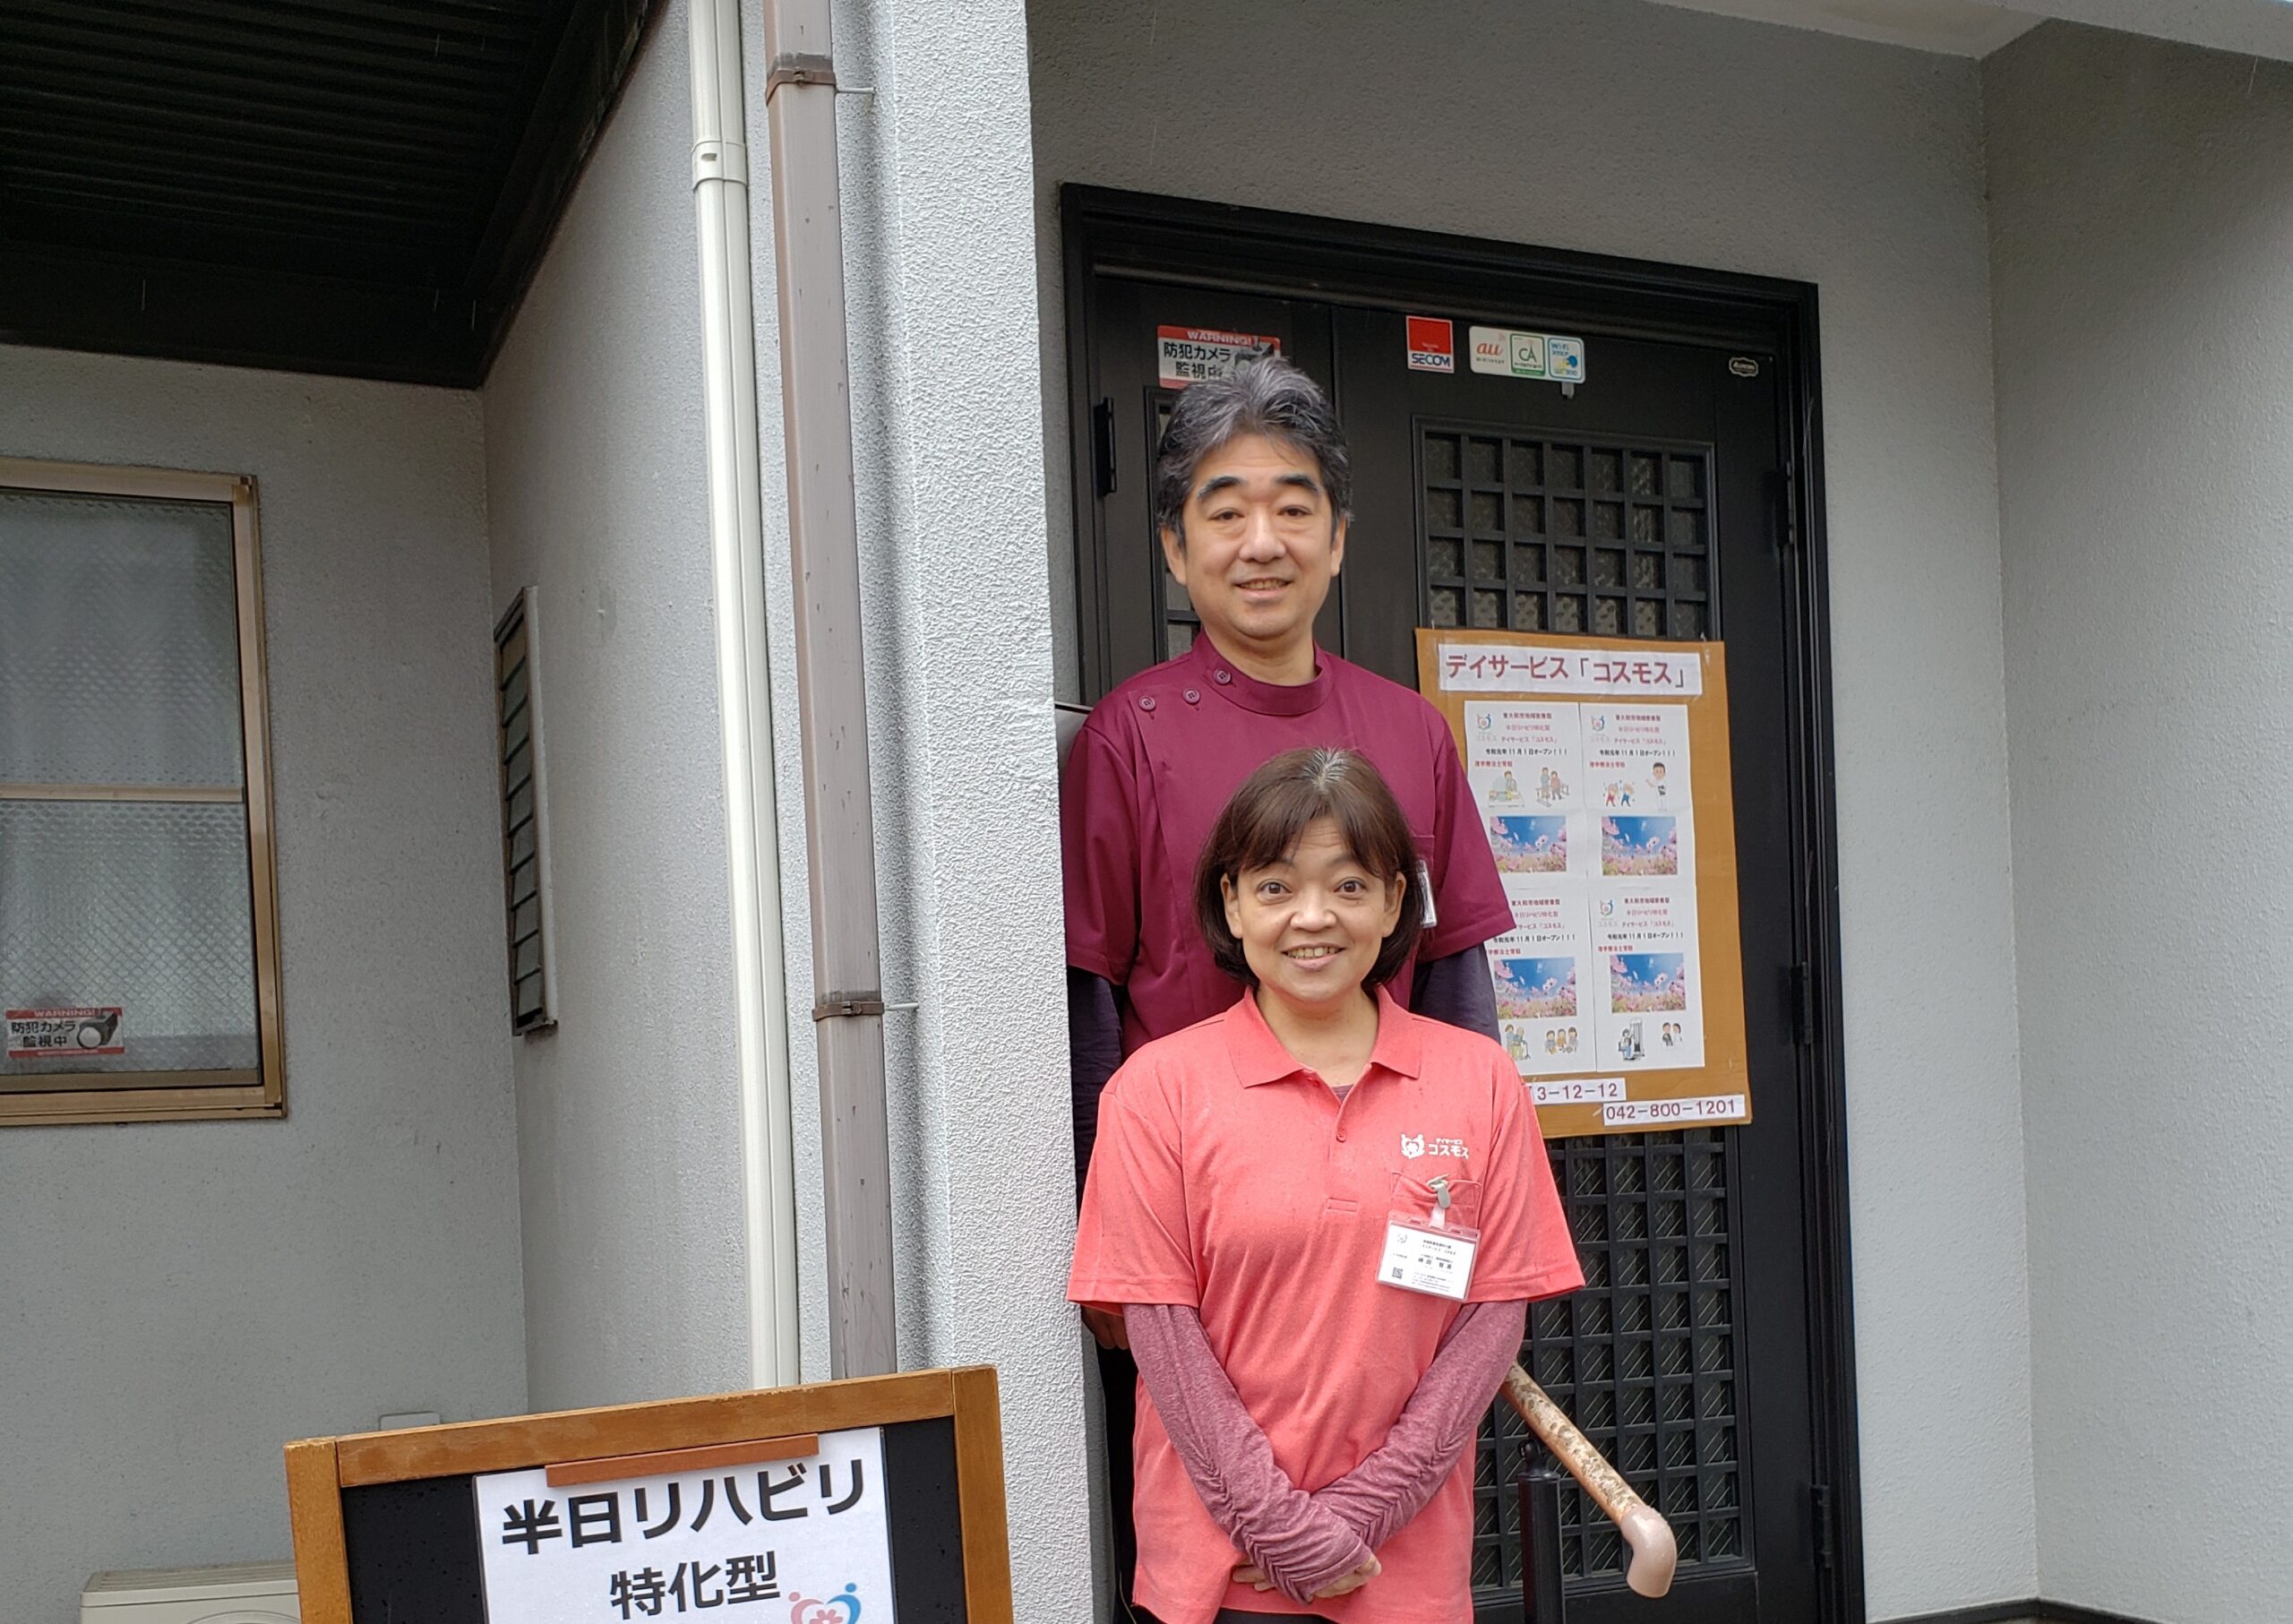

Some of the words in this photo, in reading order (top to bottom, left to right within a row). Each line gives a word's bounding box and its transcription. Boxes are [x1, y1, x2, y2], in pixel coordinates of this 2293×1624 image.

[1187, 330, 1252, 347] WARNING!
[1164, 341, 1232, 363] 防犯カメラ
[1476, 342, 1504, 357] au
[1412, 353, 1450, 367] SECOM
[1446, 653, 1685, 689] デイサービス「コスモス」
[34, 1010, 96, 1018] WARNING!
[11, 1020, 76, 1035] 防犯カメラ
[23, 1035, 67, 1047] 監視中
[1529, 1083, 1618, 1101] 3-12-12
[1606, 1099, 1735, 1121] 042-800-1201
[1429, 1143, 1469, 1159] コスモス
[502, 1457, 866, 1556] 半日リハビリ
[610, 1551, 780, 1620] 特化型
